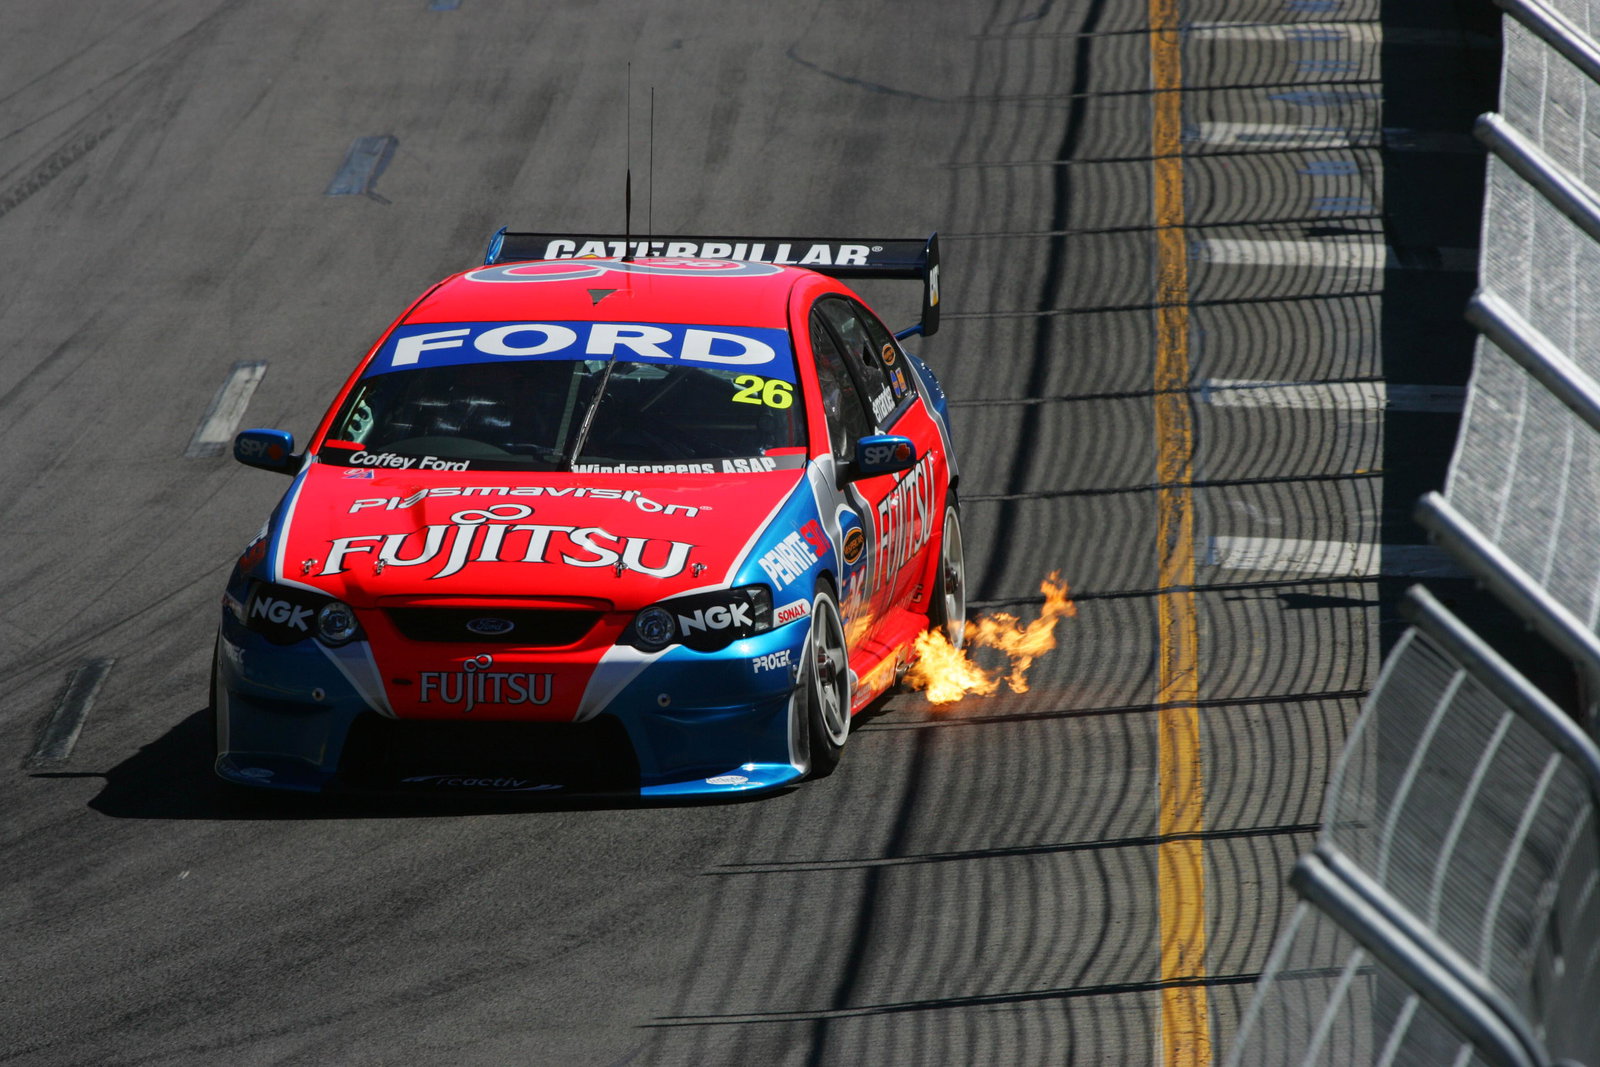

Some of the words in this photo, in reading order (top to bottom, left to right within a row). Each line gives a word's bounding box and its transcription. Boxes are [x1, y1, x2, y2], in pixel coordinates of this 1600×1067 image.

[391, 323, 775, 367] FORD
[732, 375, 794, 410] 26
[240, 438, 269, 457] SPY
[349, 451, 416, 469] Coffey
[418, 455, 470, 472] Ford
[864, 444, 896, 464] SPY
[573, 463, 714, 474] Windscreens
[722, 456, 776, 473] ASAP
[316, 522, 697, 580] FUJITSU
[758, 531, 818, 591] PENRITE
[251, 596, 314, 632] NGK
[678, 601, 753, 637] NGK
[778, 604, 806, 624] SONAX
[753, 649, 791, 674] PROTEC
[418, 671, 552, 712] FUJITSU
[436, 776, 528, 788] reactiv
